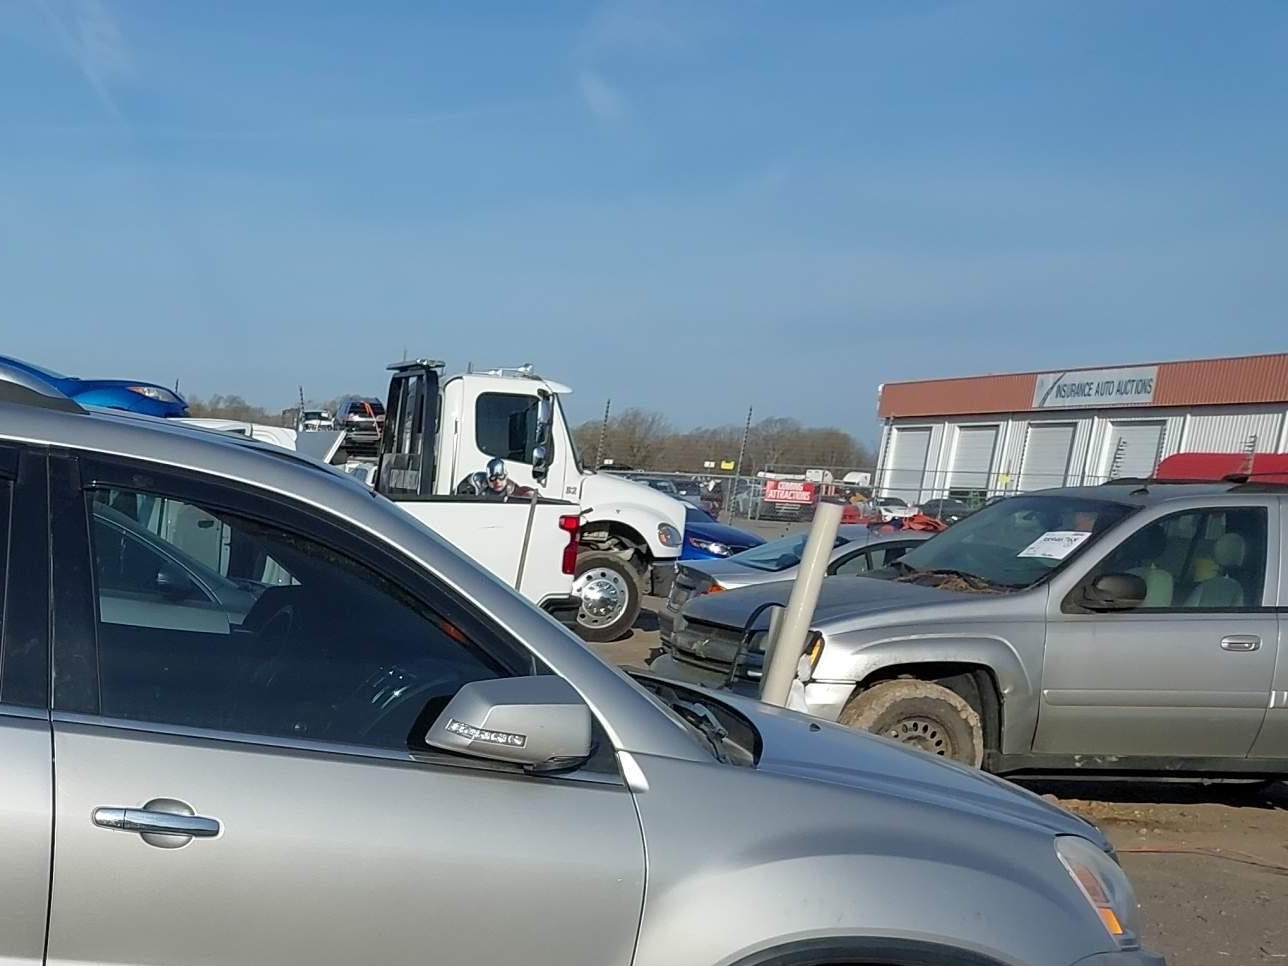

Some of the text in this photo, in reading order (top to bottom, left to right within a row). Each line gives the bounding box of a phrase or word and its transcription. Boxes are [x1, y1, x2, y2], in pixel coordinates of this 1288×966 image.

[1055, 378, 1153, 398] INSURANCE AUTO AUCTIONS
[767, 489, 811, 501] ATTRACTIONS
